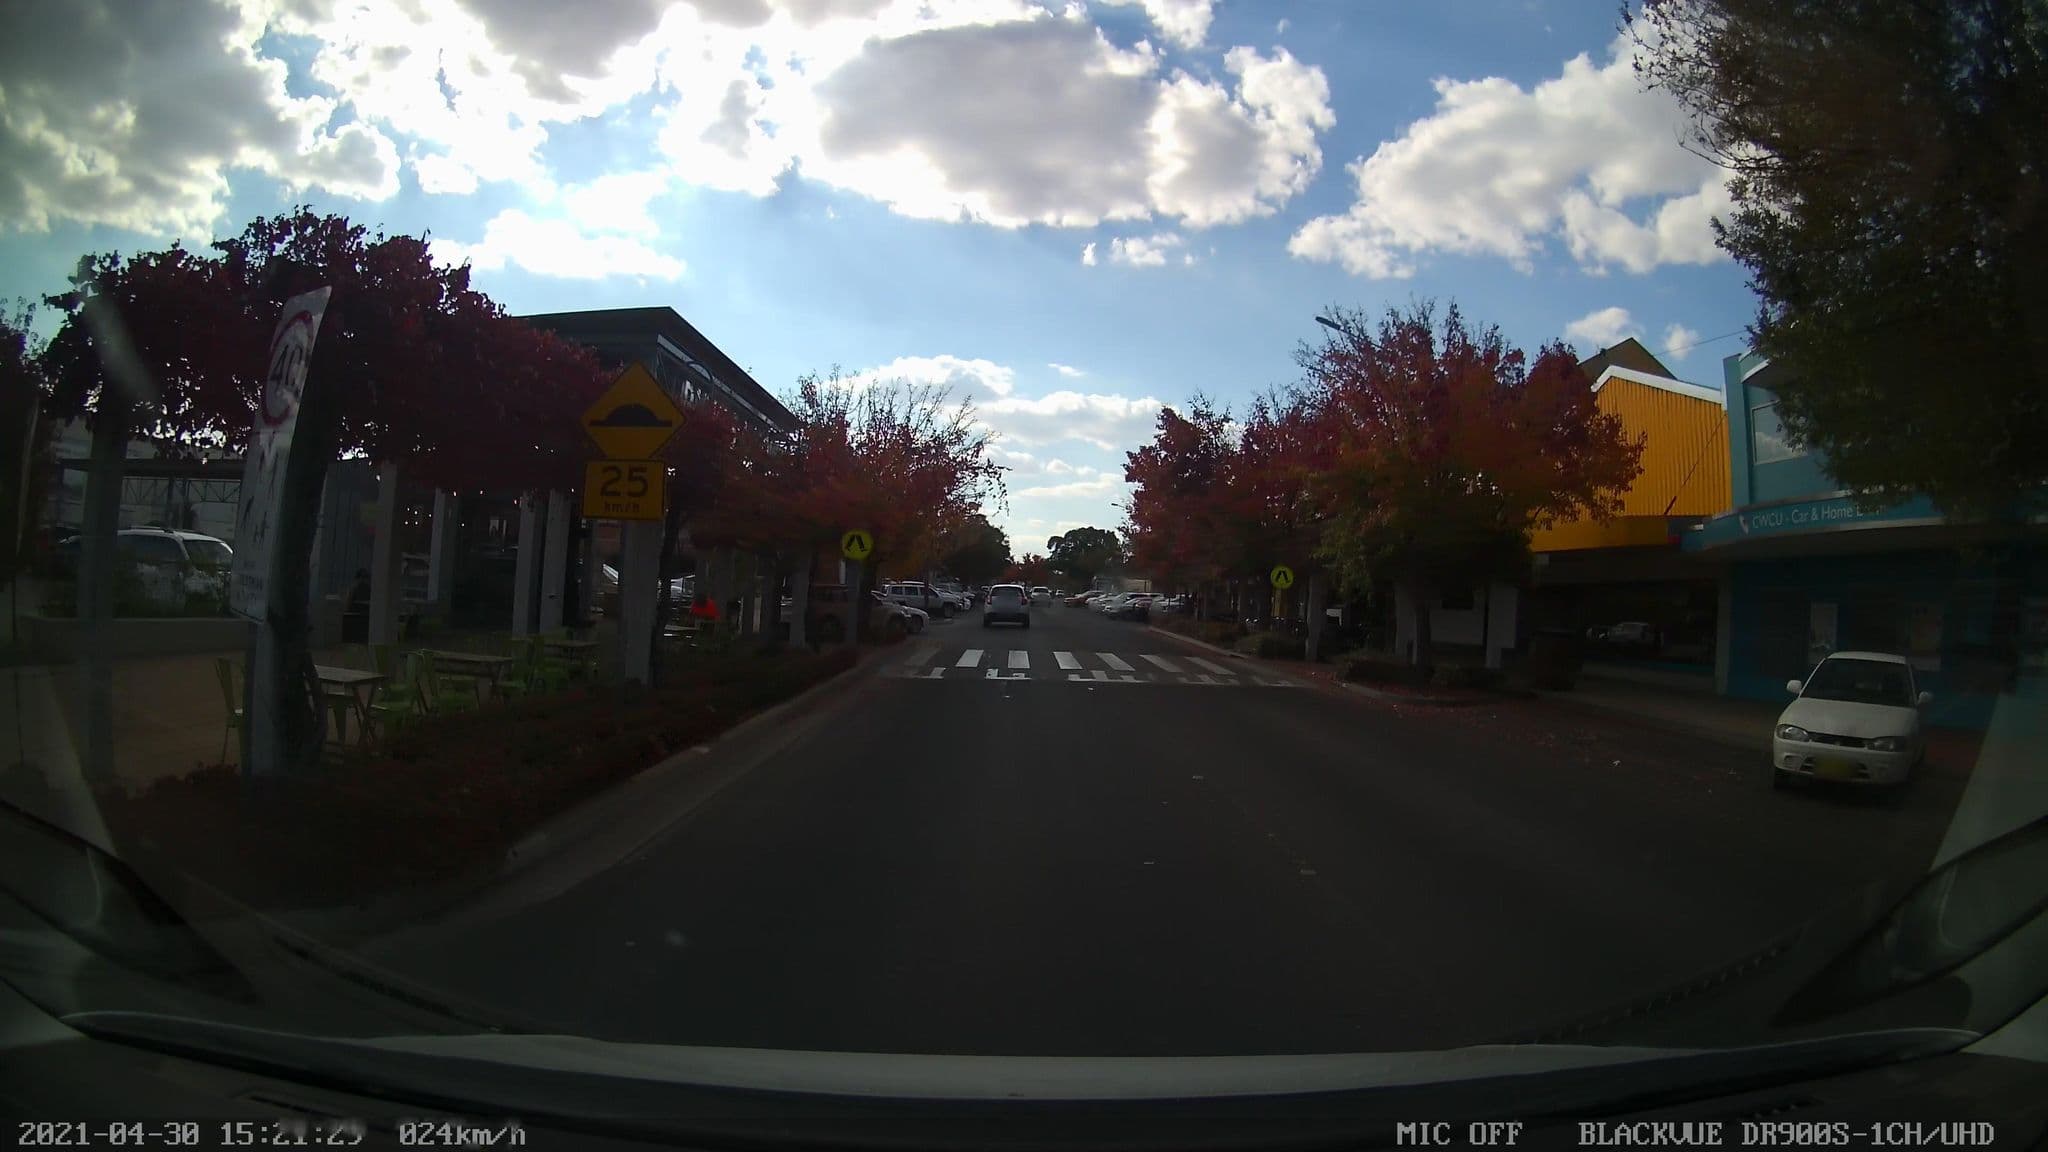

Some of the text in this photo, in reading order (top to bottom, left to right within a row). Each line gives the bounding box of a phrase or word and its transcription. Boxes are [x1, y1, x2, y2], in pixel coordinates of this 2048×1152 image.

[600, 466, 648, 497] 25
[1791, 507, 1809, 524] Car
[1811, 508, 1819, 521] &
[1821, 504, 1853, 520] Home
